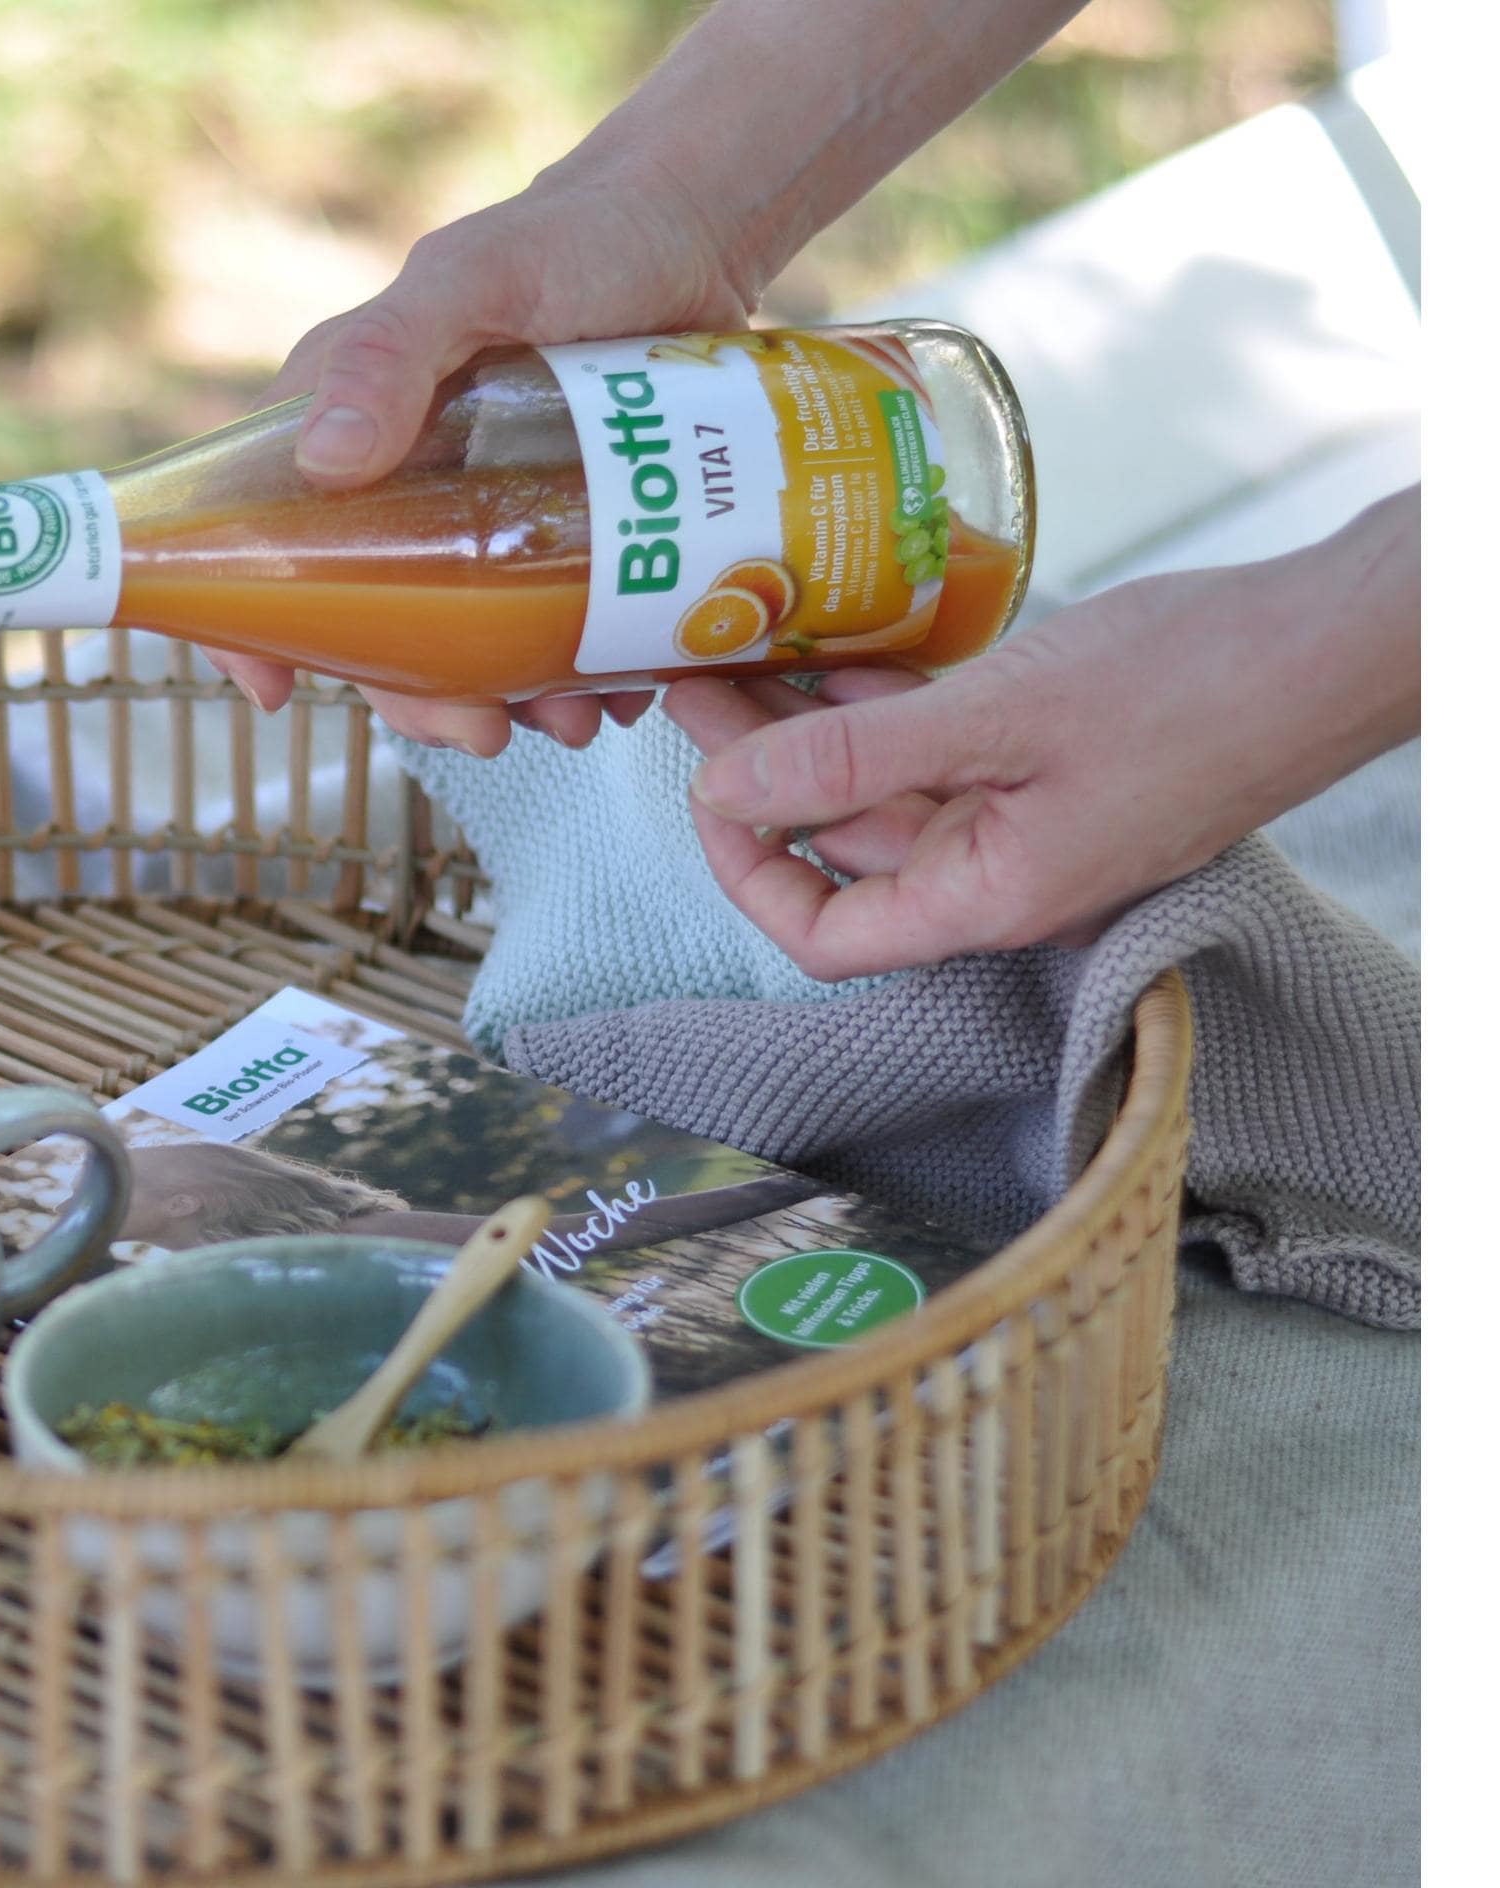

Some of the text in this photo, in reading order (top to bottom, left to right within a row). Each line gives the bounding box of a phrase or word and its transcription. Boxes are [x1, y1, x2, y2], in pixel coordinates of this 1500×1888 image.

[781, 363, 820, 452] Der fruchtige
[800, 363, 820, 385] mit
[828, 376, 853, 432] classique
[810, 386, 839, 451] Klassiker
[842, 375, 873, 448] au petit-lait
[844, 434, 857, 450] Le
[602, 371, 681, 596] Biotta
[694, 422, 736, 520] VITA 7
[81, 501, 99, 521] gut
[809, 475, 829, 583] Vitamin C für
[822, 474, 850, 613] das Immunsystem
[846, 472, 867, 598] Vitamine C pour le
[861, 472, 881, 612] système immunitaire
[83, 522, 101, 581] Natürlich
[181, 1046, 309, 1116] Biotta
[237, 1086, 280, 1113] Schweizer
[519, 1178, 659, 1286] Woche
[779, 1271, 832, 1316] Mit vielen
[792, 1261, 872, 1337] hilfreichen Tipps
[842, 1288, 883, 1320] Tricks.
